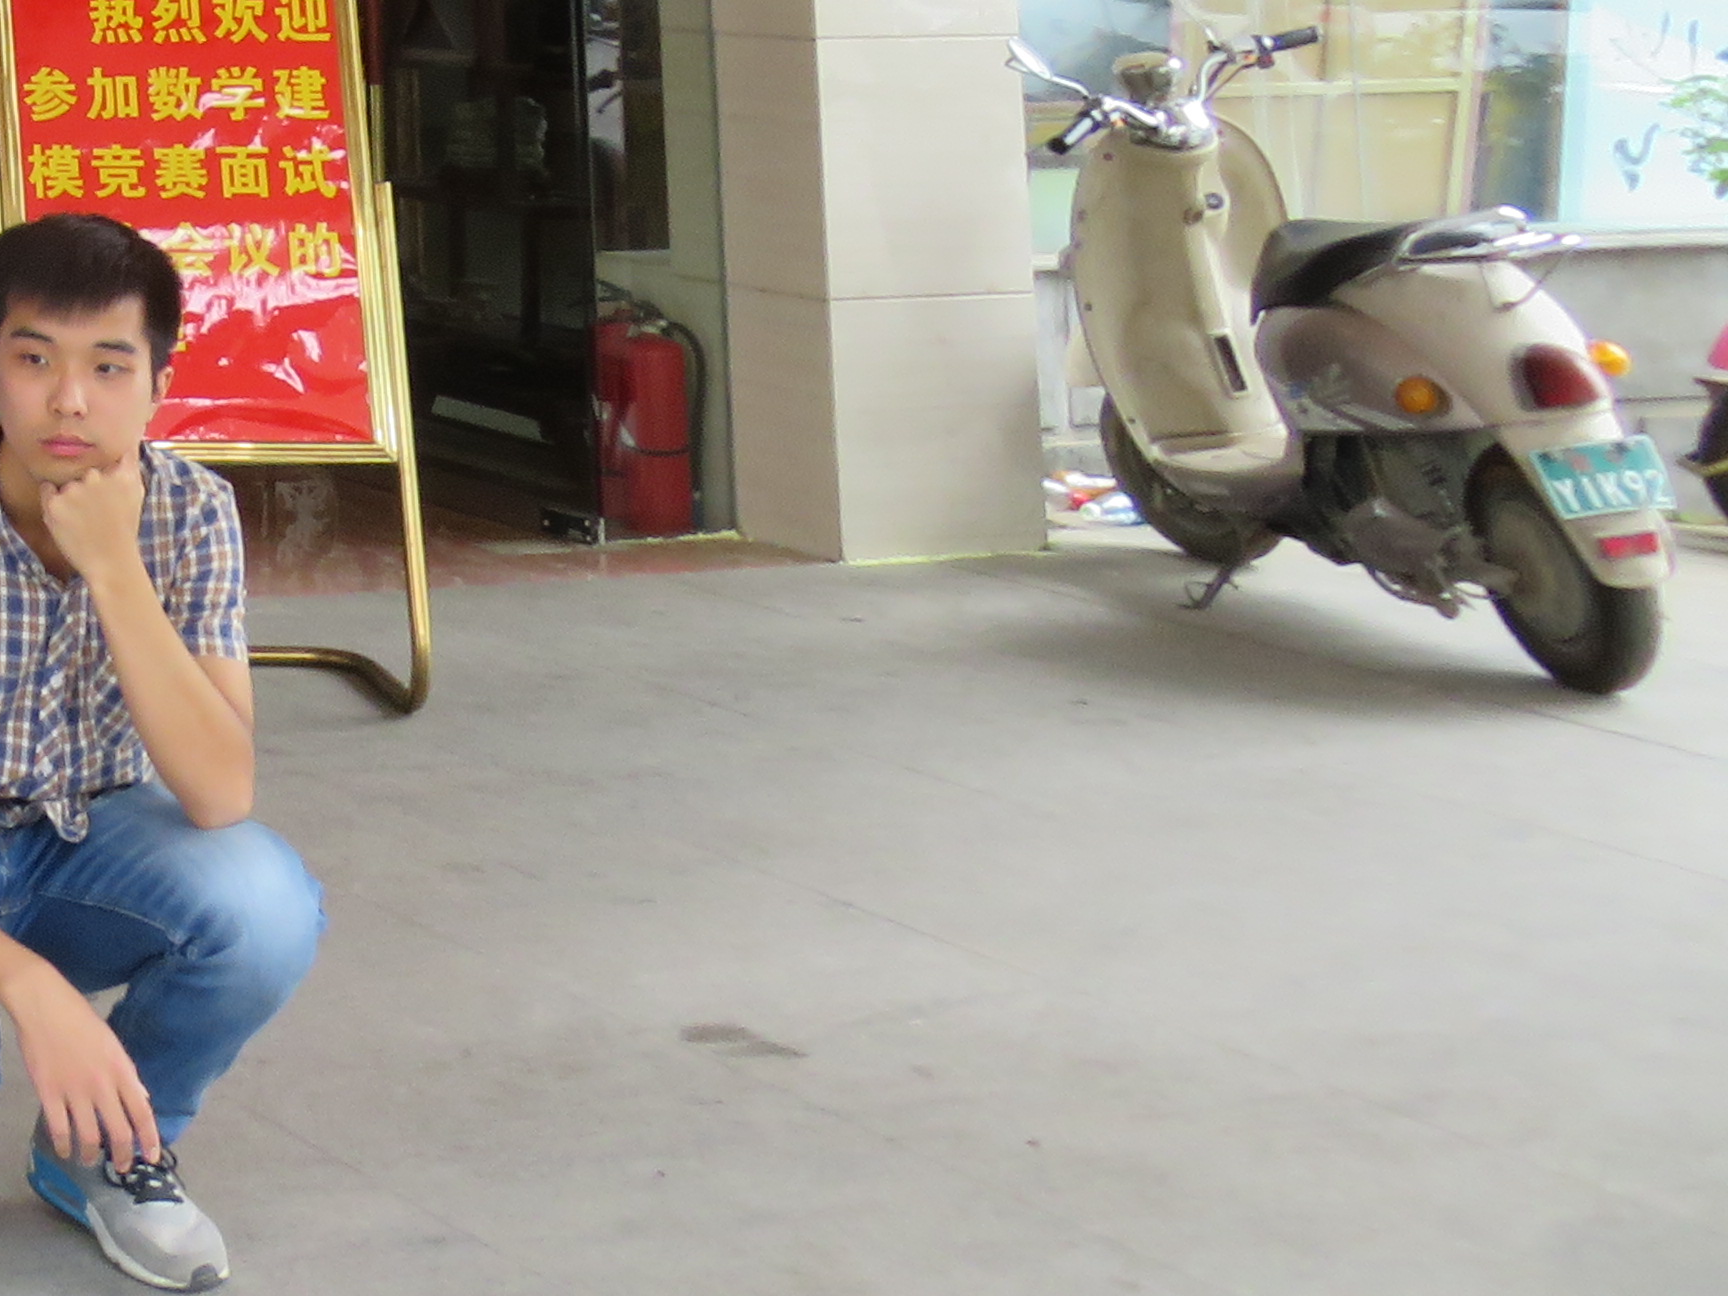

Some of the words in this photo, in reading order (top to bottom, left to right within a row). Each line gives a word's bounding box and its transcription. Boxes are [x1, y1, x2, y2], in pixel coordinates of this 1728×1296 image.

[23, 66, 331, 123] 参加数学建
[28, 144, 339, 200] 模竞赛面试
[124, 221, 343, 278] 会议的
